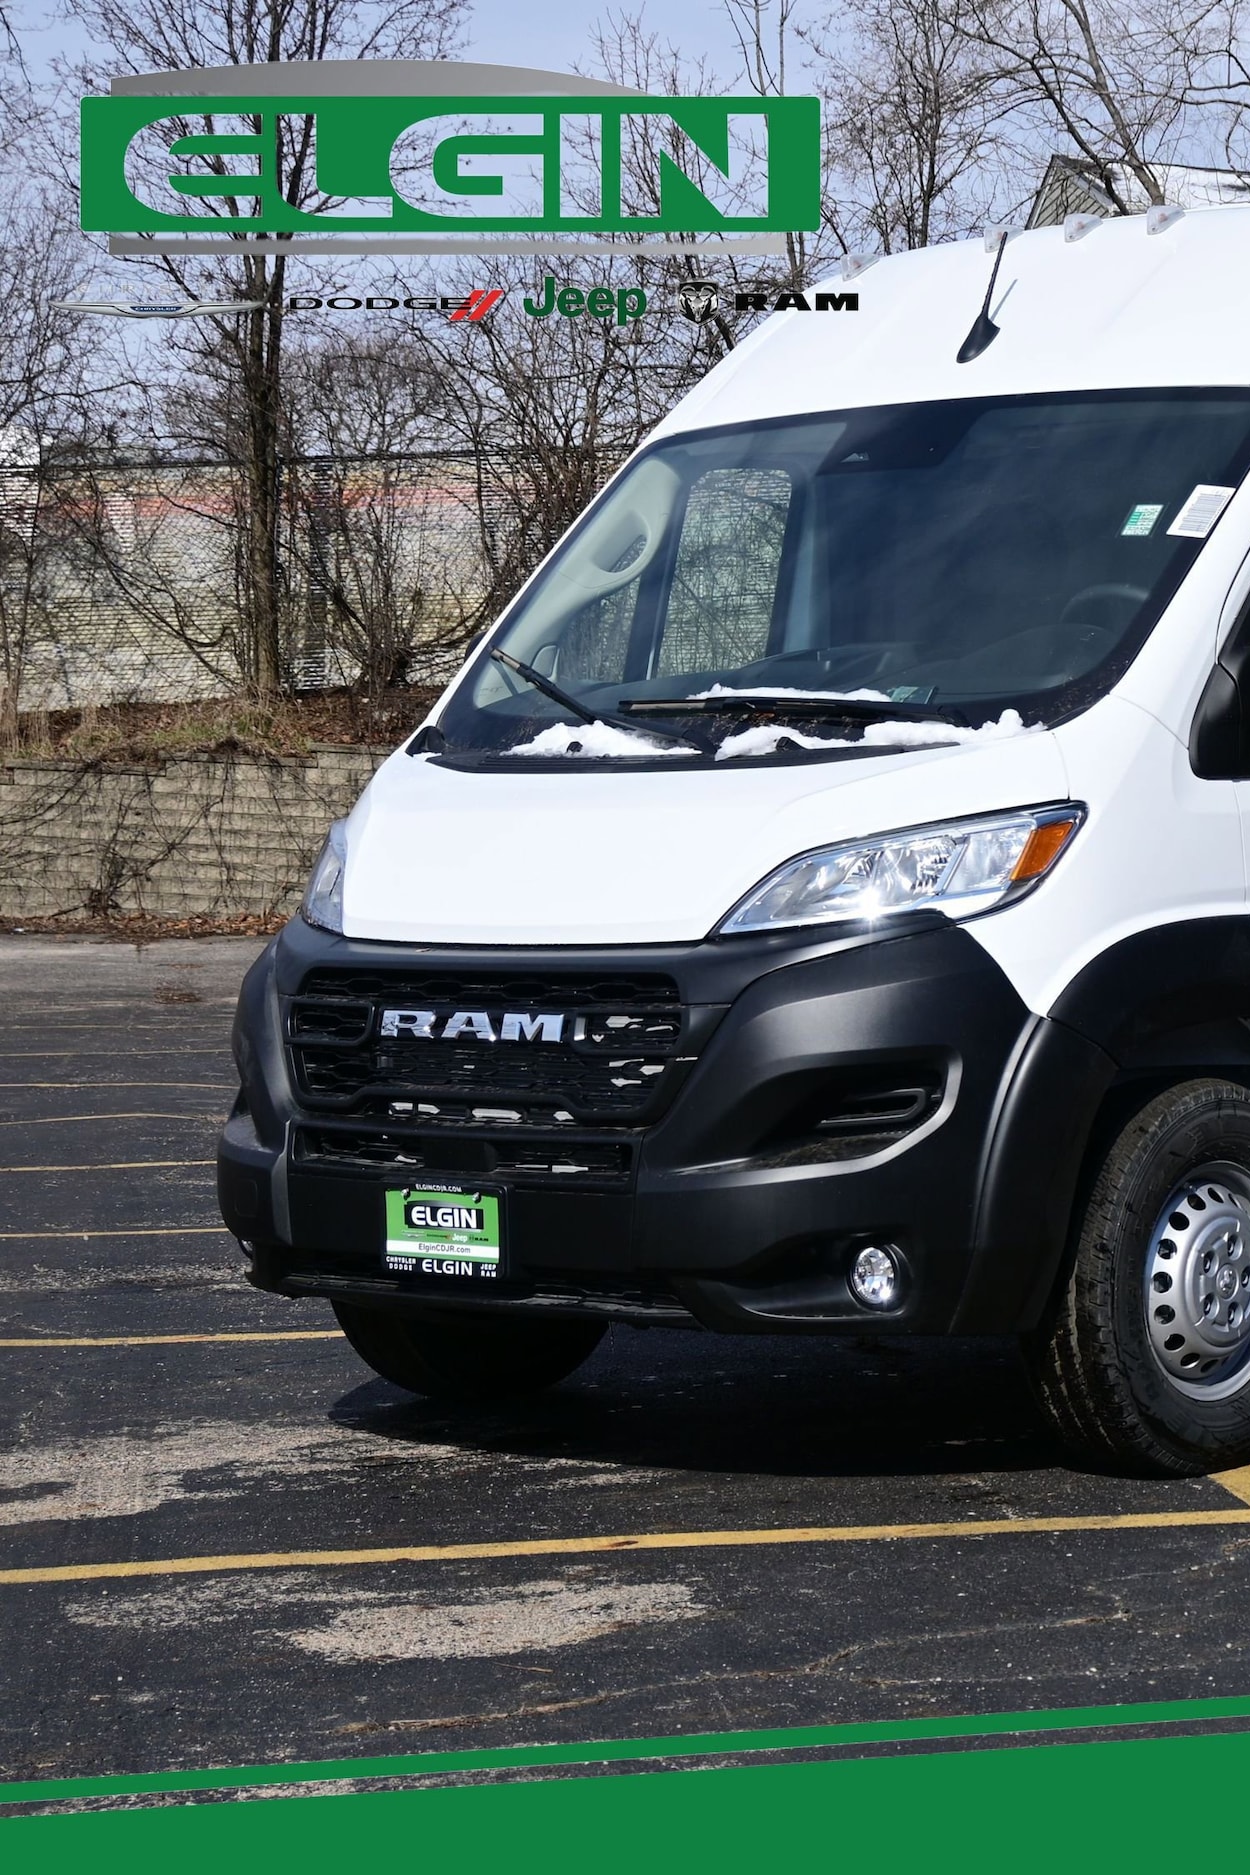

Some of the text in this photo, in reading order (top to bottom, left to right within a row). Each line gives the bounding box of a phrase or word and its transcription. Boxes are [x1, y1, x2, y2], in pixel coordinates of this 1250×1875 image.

[380, 1010, 564, 1043] RAM
[415, 1184, 462, 1193] ELGINCDJR.COM
[411, 1206, 477, 1229] ELGIN
[452, 1233, 468, 1242] Jeep
[418, 1243, 471, 1254] ElginCDJR.com
[389, 1263, 413, 1271] DODGE
[422, 1259, 473, 1276] ELGIN
